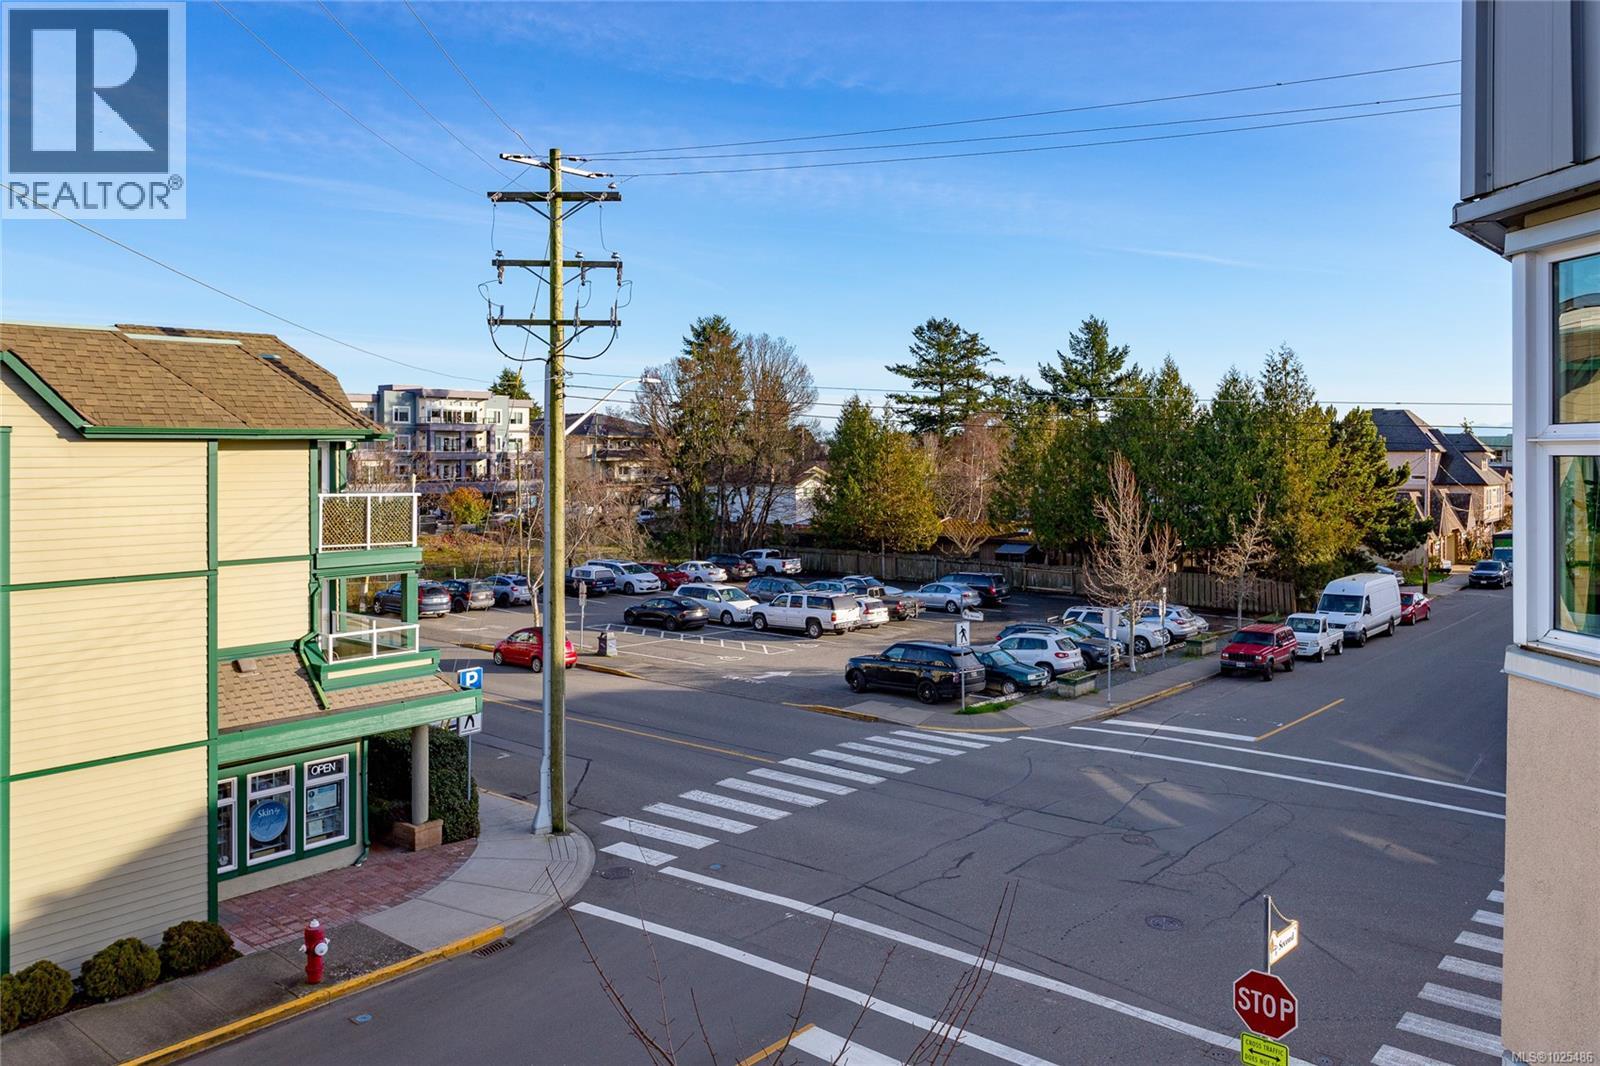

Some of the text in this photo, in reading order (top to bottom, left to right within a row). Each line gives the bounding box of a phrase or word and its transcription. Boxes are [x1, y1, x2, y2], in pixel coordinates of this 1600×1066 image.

[466, 671, 478, 687] P
[311, 762, 336, 776] OPEN
[257, 808, 274, 818] Skin
[1238, 987, 1294, 1021] STOP
[1245, 1039, 1284, 1057] CROSS TRAFFIC
